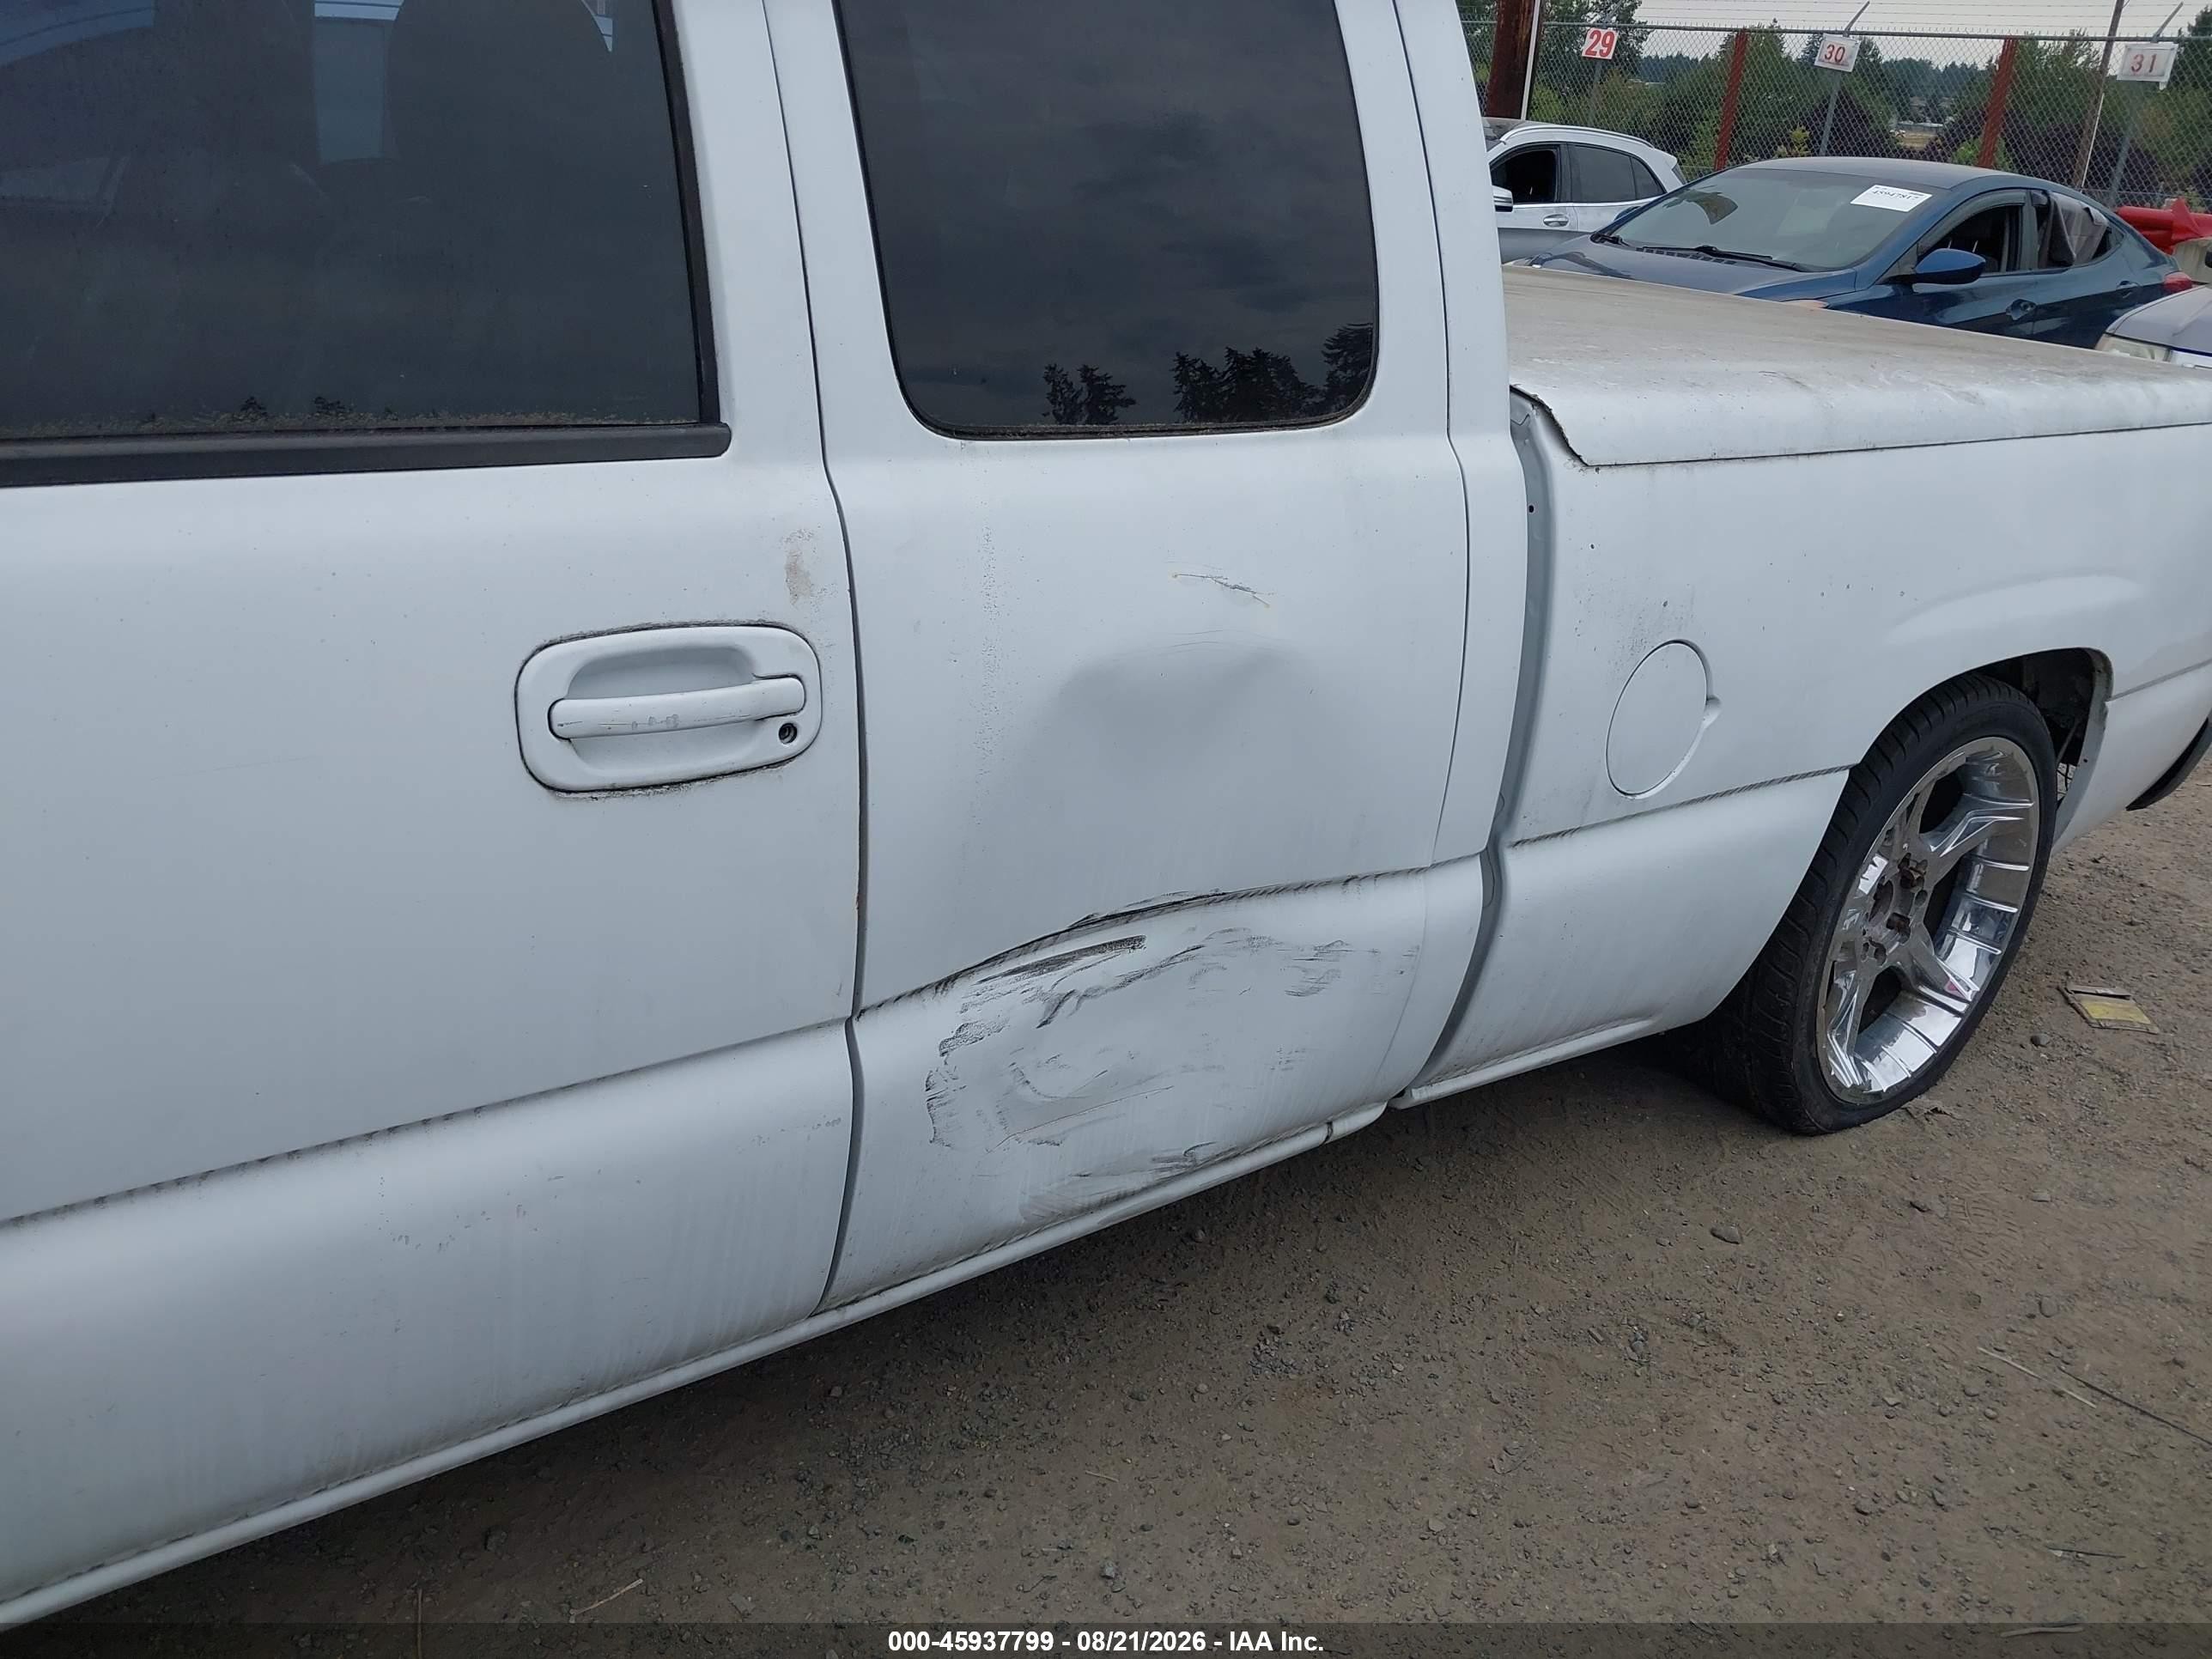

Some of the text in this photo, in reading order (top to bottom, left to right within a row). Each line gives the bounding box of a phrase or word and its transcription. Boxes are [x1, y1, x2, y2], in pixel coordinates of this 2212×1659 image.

[1585, 29, 1615, 58] 29
[1824, 44, 1845, 64] 30
[2131, 53, 2157, 74] 31
